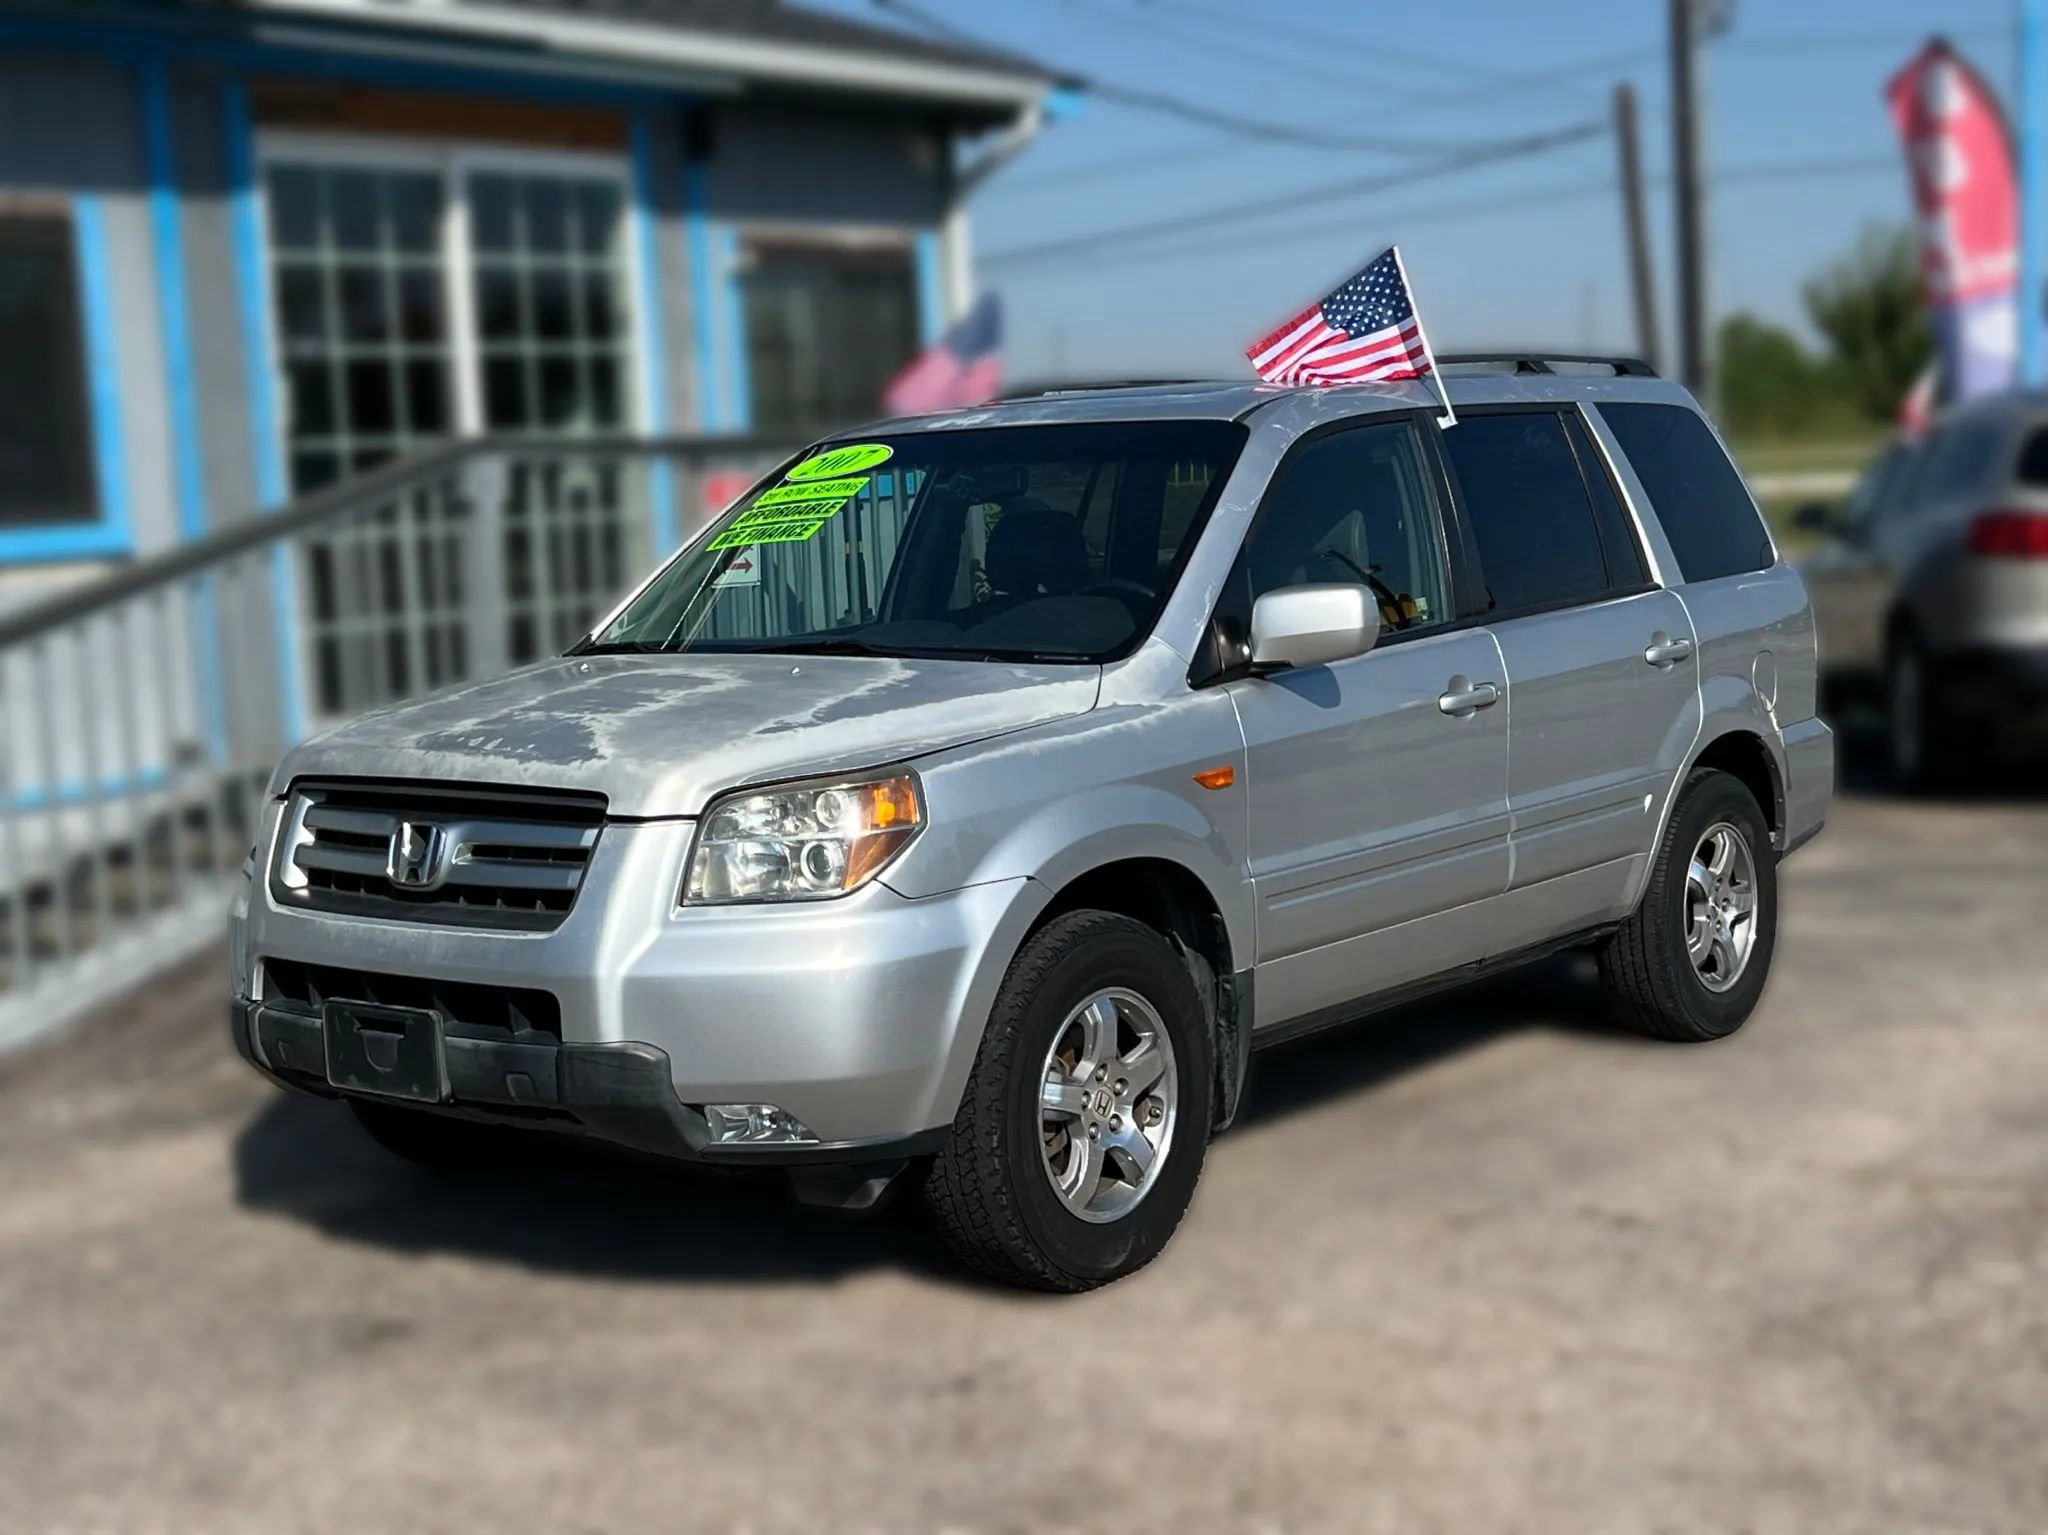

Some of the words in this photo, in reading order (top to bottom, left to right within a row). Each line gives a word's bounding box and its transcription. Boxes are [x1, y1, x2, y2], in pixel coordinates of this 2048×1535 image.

[797, 449, 882, 477] 2007
[737, 501, 843, 524] AFFORDABLE
[712, 529, 747, 548] WE
[736, 522, 820, 543] FINANCE
